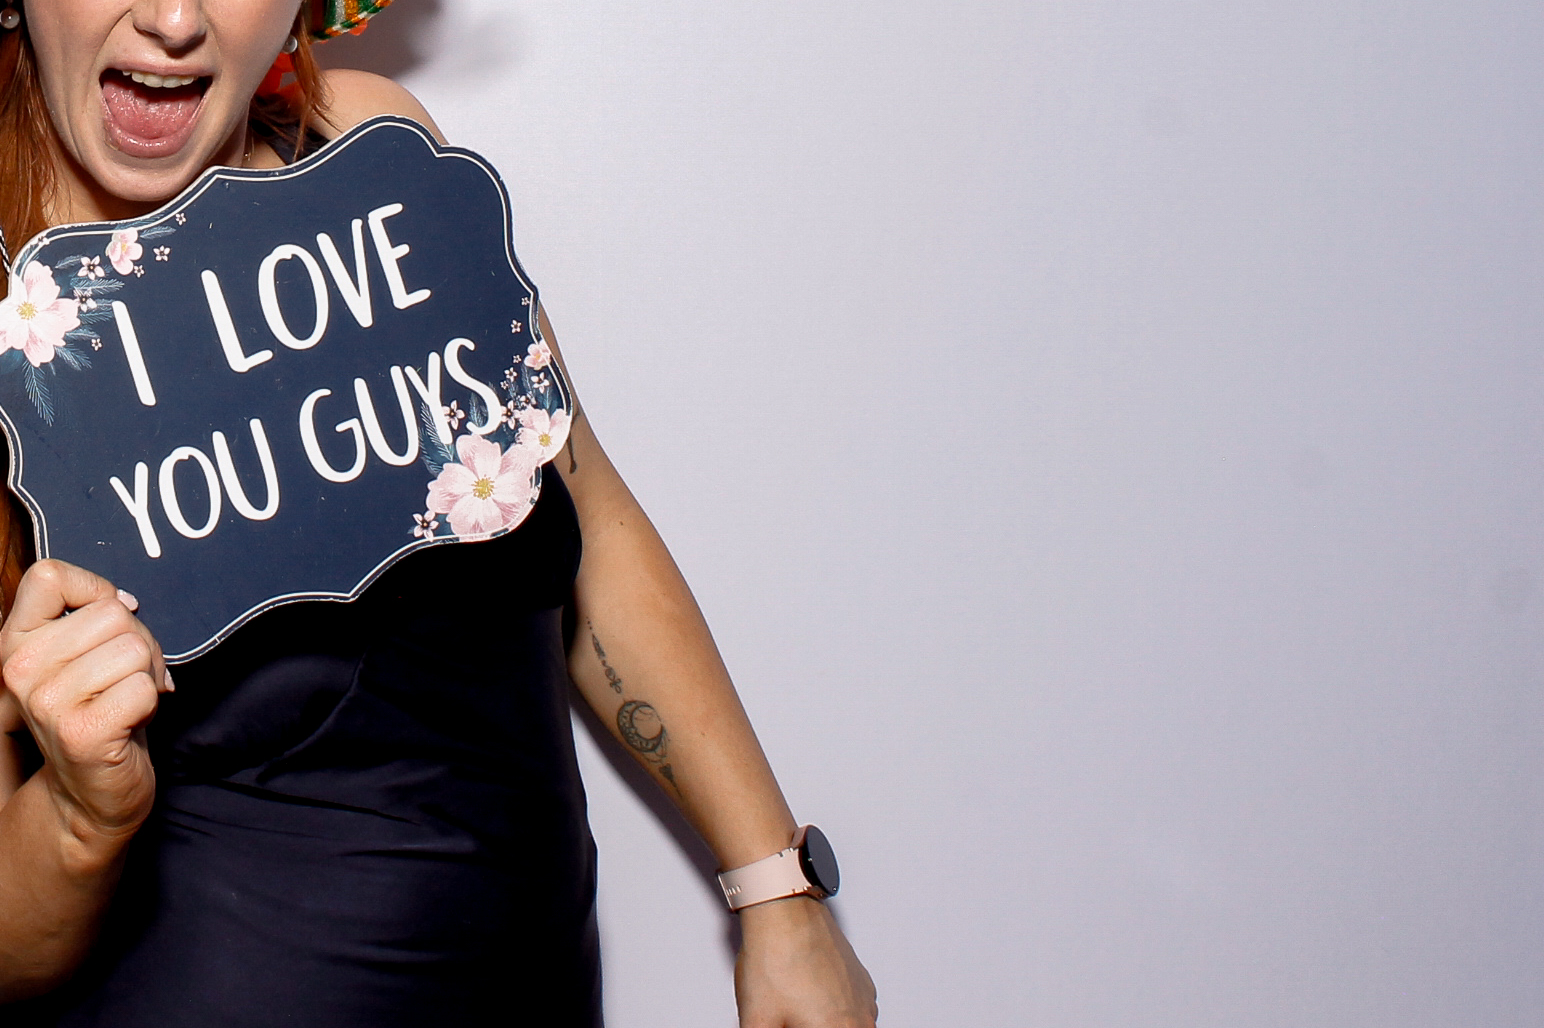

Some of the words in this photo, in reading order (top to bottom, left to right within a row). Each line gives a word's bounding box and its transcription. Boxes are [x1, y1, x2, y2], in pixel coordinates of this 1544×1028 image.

[112, 300, 156, 406] I
[201, 202, 431, 373] LOVE
[109, 418, 280, 558] YOU
[299, 337, 502, 483] GUYS
